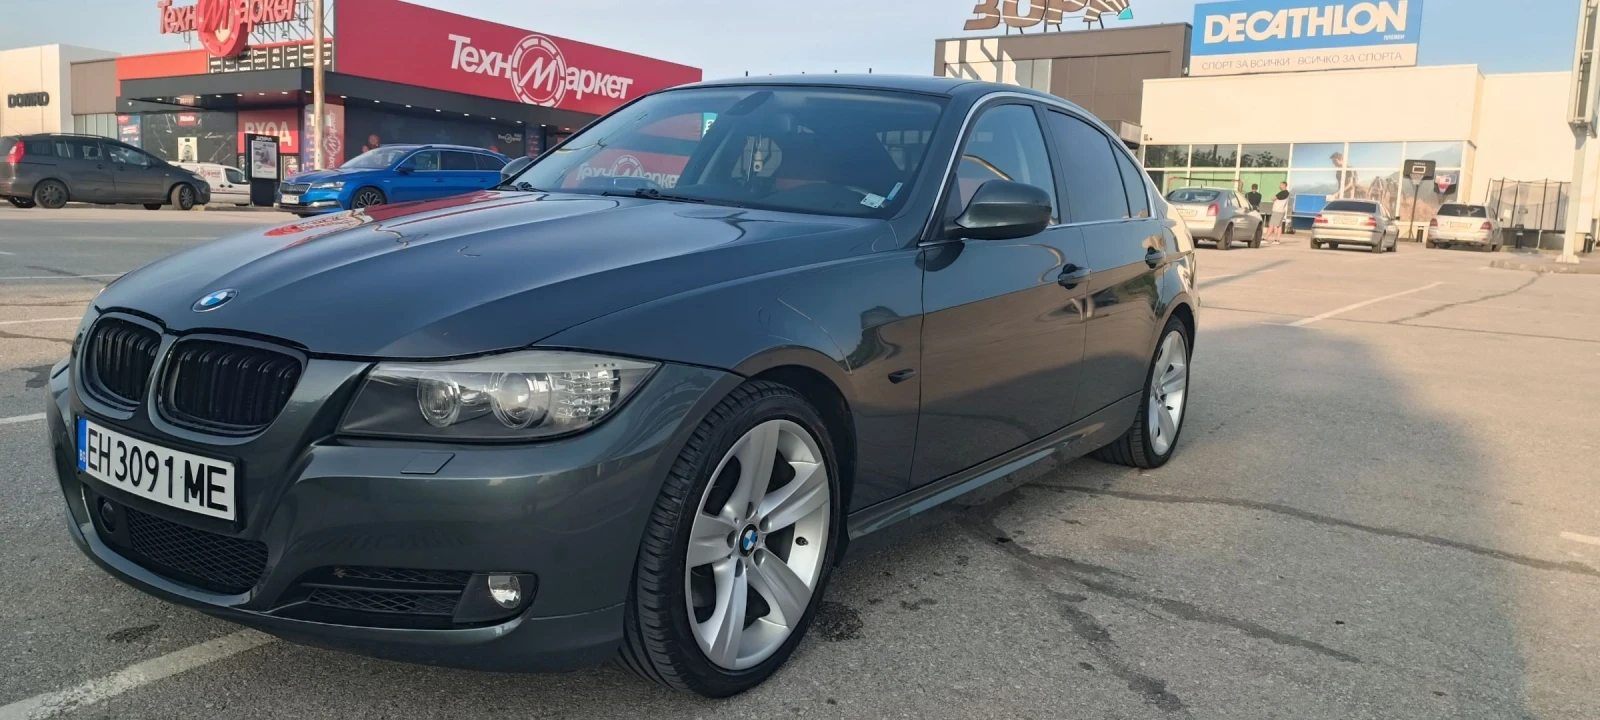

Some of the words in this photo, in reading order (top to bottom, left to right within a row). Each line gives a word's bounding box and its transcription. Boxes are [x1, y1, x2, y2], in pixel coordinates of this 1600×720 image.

[1203, 0, 1408, 44] DECATHLON
[1202, 61, 1234, 70] СПОРТ
[1236, 60, 1248, 69] ЗА
[1250, 57, 1290, 68] ВСИЧКИ
[1297, 55, 1339, 65] ВСИЧКО
[1342, 54, 1356, 63] ЗА
[1358, 51, 1402, 62] СПОРТА
[115, 440, 174, 499] 3091
[184, 459, 228, 512] ME
